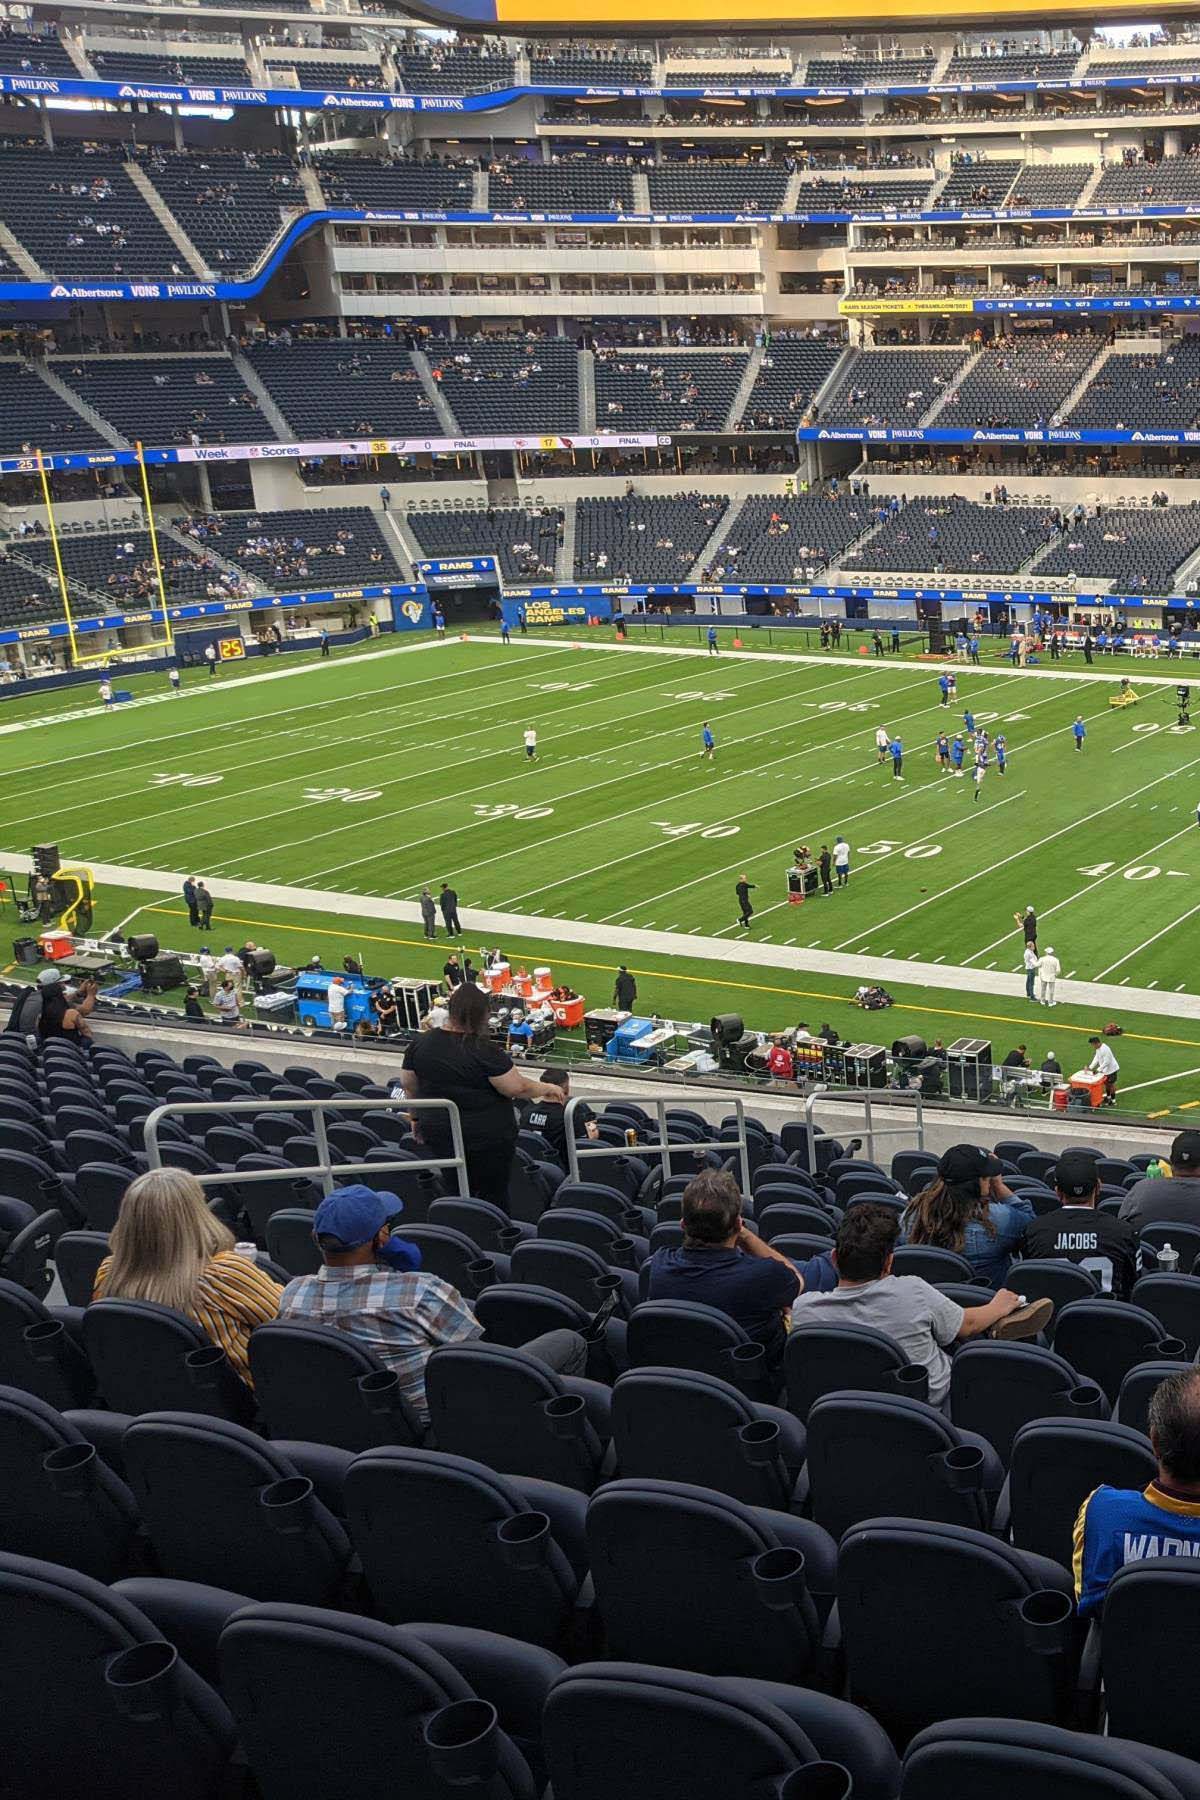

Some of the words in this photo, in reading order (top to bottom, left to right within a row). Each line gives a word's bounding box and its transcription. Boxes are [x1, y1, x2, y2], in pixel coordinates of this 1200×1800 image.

[12, 80, 59, 92] PAVILIONS
[136, 89, 182, 100] Albertsons
[189, 90, 215, 100] VONS
[223, 90, 266, 103] PAVILIONS
[340, 98, 385, 107] Albertsons
[390, 98, 414, 108] VONS
[421, 98, 463, 110] PAVILIONS
[71, 288, 123, 297] Albertsons
[131, 286, 160, 296] VONS
[168, 285, 216, 297] PAVILIONS
[830, 431, 863, 440] Albertsons
[868, 430, 886, 438] VONS
[892, 430, 924, 439] PAVILIONS
[986, 432, 1019, 440] Albertsons
[1024, 430, 1043, 440] VONS
[1048, 430, 1081, 440] PAVILIONS
[1144, 432, 1178, 440] Albertsons
[454, 440, 477, 448] FINAL
[544, 438, 553, 446] 17
[618, 437, 641, 445] FINAL
[195, 450, 228, 459] Week
[262, 446, 300, 457] Scores
[440, 562, 473, 570] RAMS
[224, 602, 254, 610] RAMS
[124, 614, 153, 623] RAMS
[18, 628, 50, 639] RAMS
[222, 642, 241, 656] 25
[857, 840, 943, 859] 50
[1076, 862, 1161, 880] 40
[556, 1008, 566, 1020] G
[1054, 1233, 1097, 1249] JACOBS
